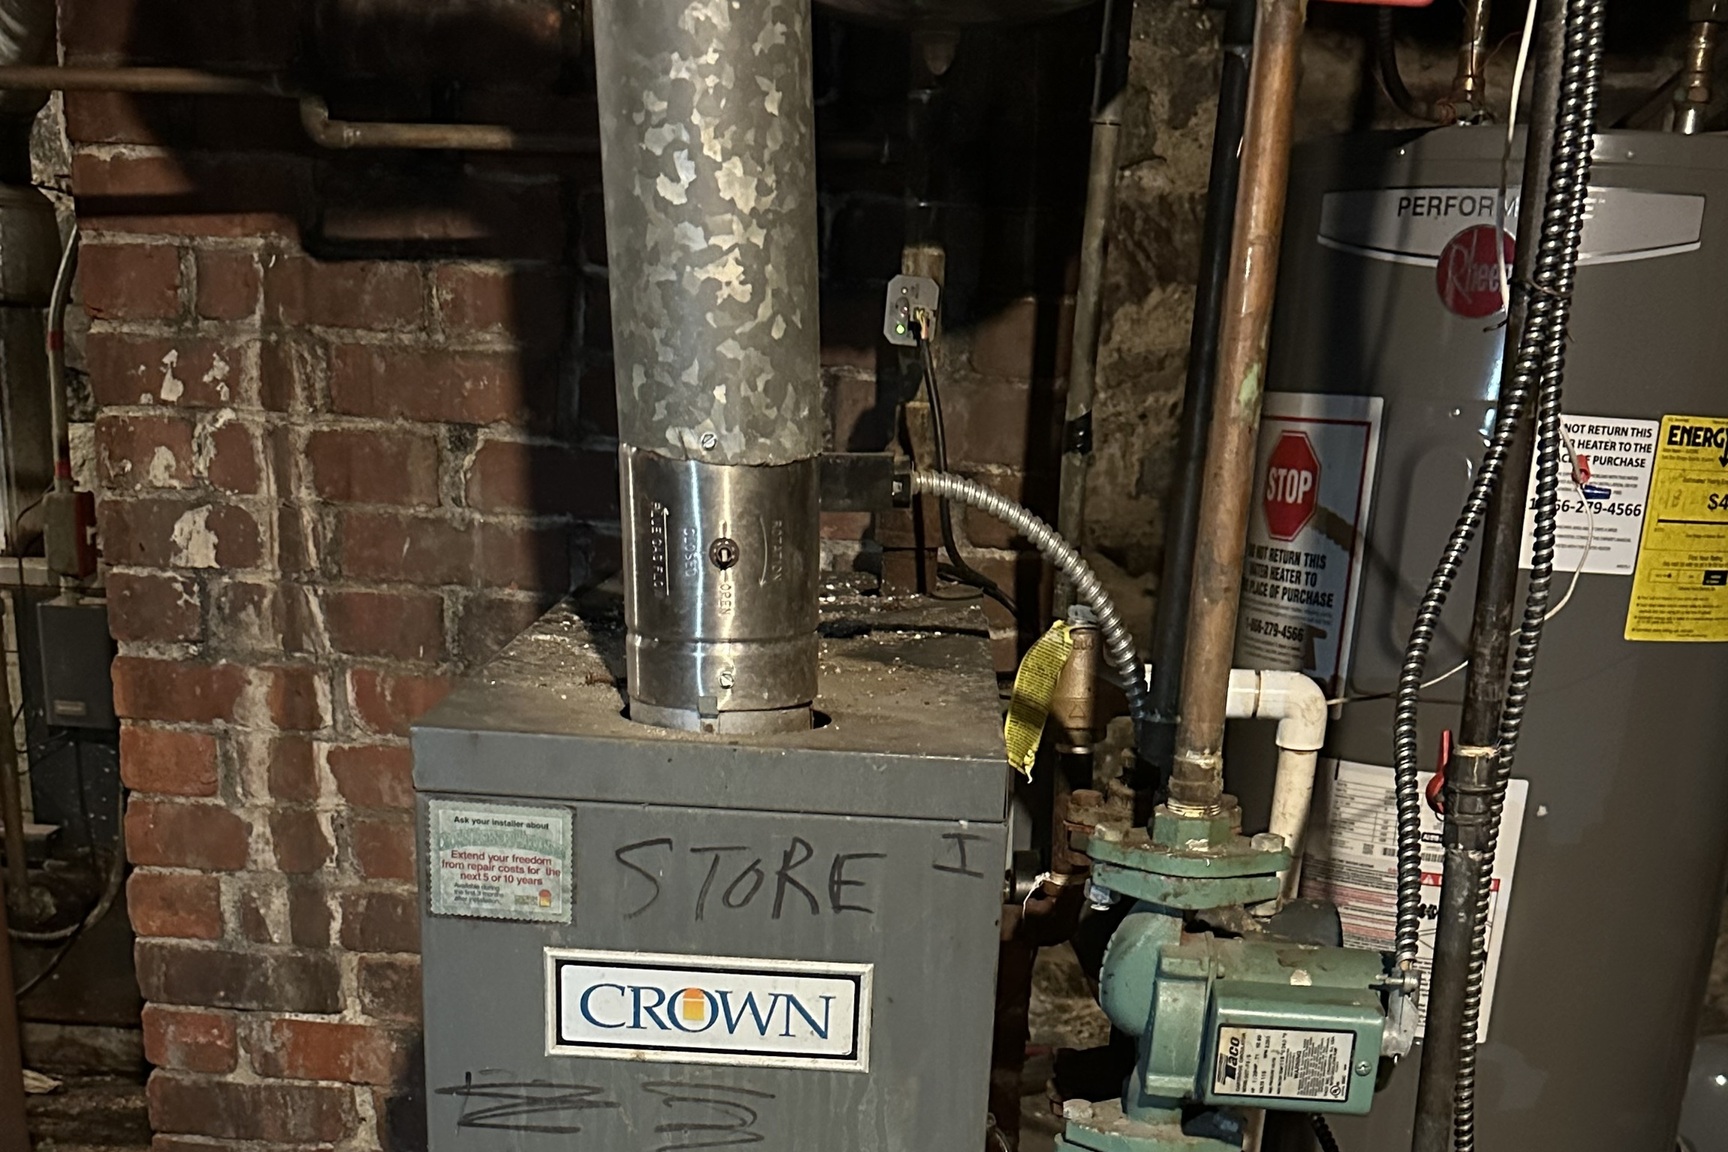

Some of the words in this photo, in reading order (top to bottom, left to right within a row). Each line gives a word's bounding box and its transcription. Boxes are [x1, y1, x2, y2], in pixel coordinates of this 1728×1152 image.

[1587, 425, 1629, 437] RETURN
[1631, 427, 1652, 438] THIS
[1577, 439, 1616, 451] HEATER
[1618, 441, 1631, 452] TO
[1633, 442, 1652, 453] THE
[1593, 455, 1646, 468] PURCHASE
[1267, 467, 1312, 504] STOP
[1529, 497, 1642, 517] 166-279-4566
[1269, 547, 1301, 566] RETURN
[1304, 553, 1326, 569] THIS
[1270, 566, 1301, 585] HEATER
[1305, 571, 1317, 587] TO
[720, 584, 733, 617] OPEN
[1281, 586, 1334, 609] PURCHASE
[454, 816, 469, 824] Ask
[471, 818, 489, 826] your
[492, 819, 524, 828] installer
[526, 821, 549, 830] about
[451, 849, 485, 861] Extend
[488, 853, 509, 864] your
[512, 854, 552, 866] freedom
[442, 860, 465, 869] from
[467, 862, 495, 873] repair
[498, 864, 525, 874] costs
[527, 865, 540, 875] for
[546, 867, 561, 877] the
[615, 836, 887, 921] STORE
[460, 872, 481, 881] next
[483, 873, 489, 882] 5
[504, 874, 514, 883] 10
[516, 876, 543, 886] years
[580, 983, 836, 1039] CROWN
[1217, 1036, 1240, 1086] Taco
